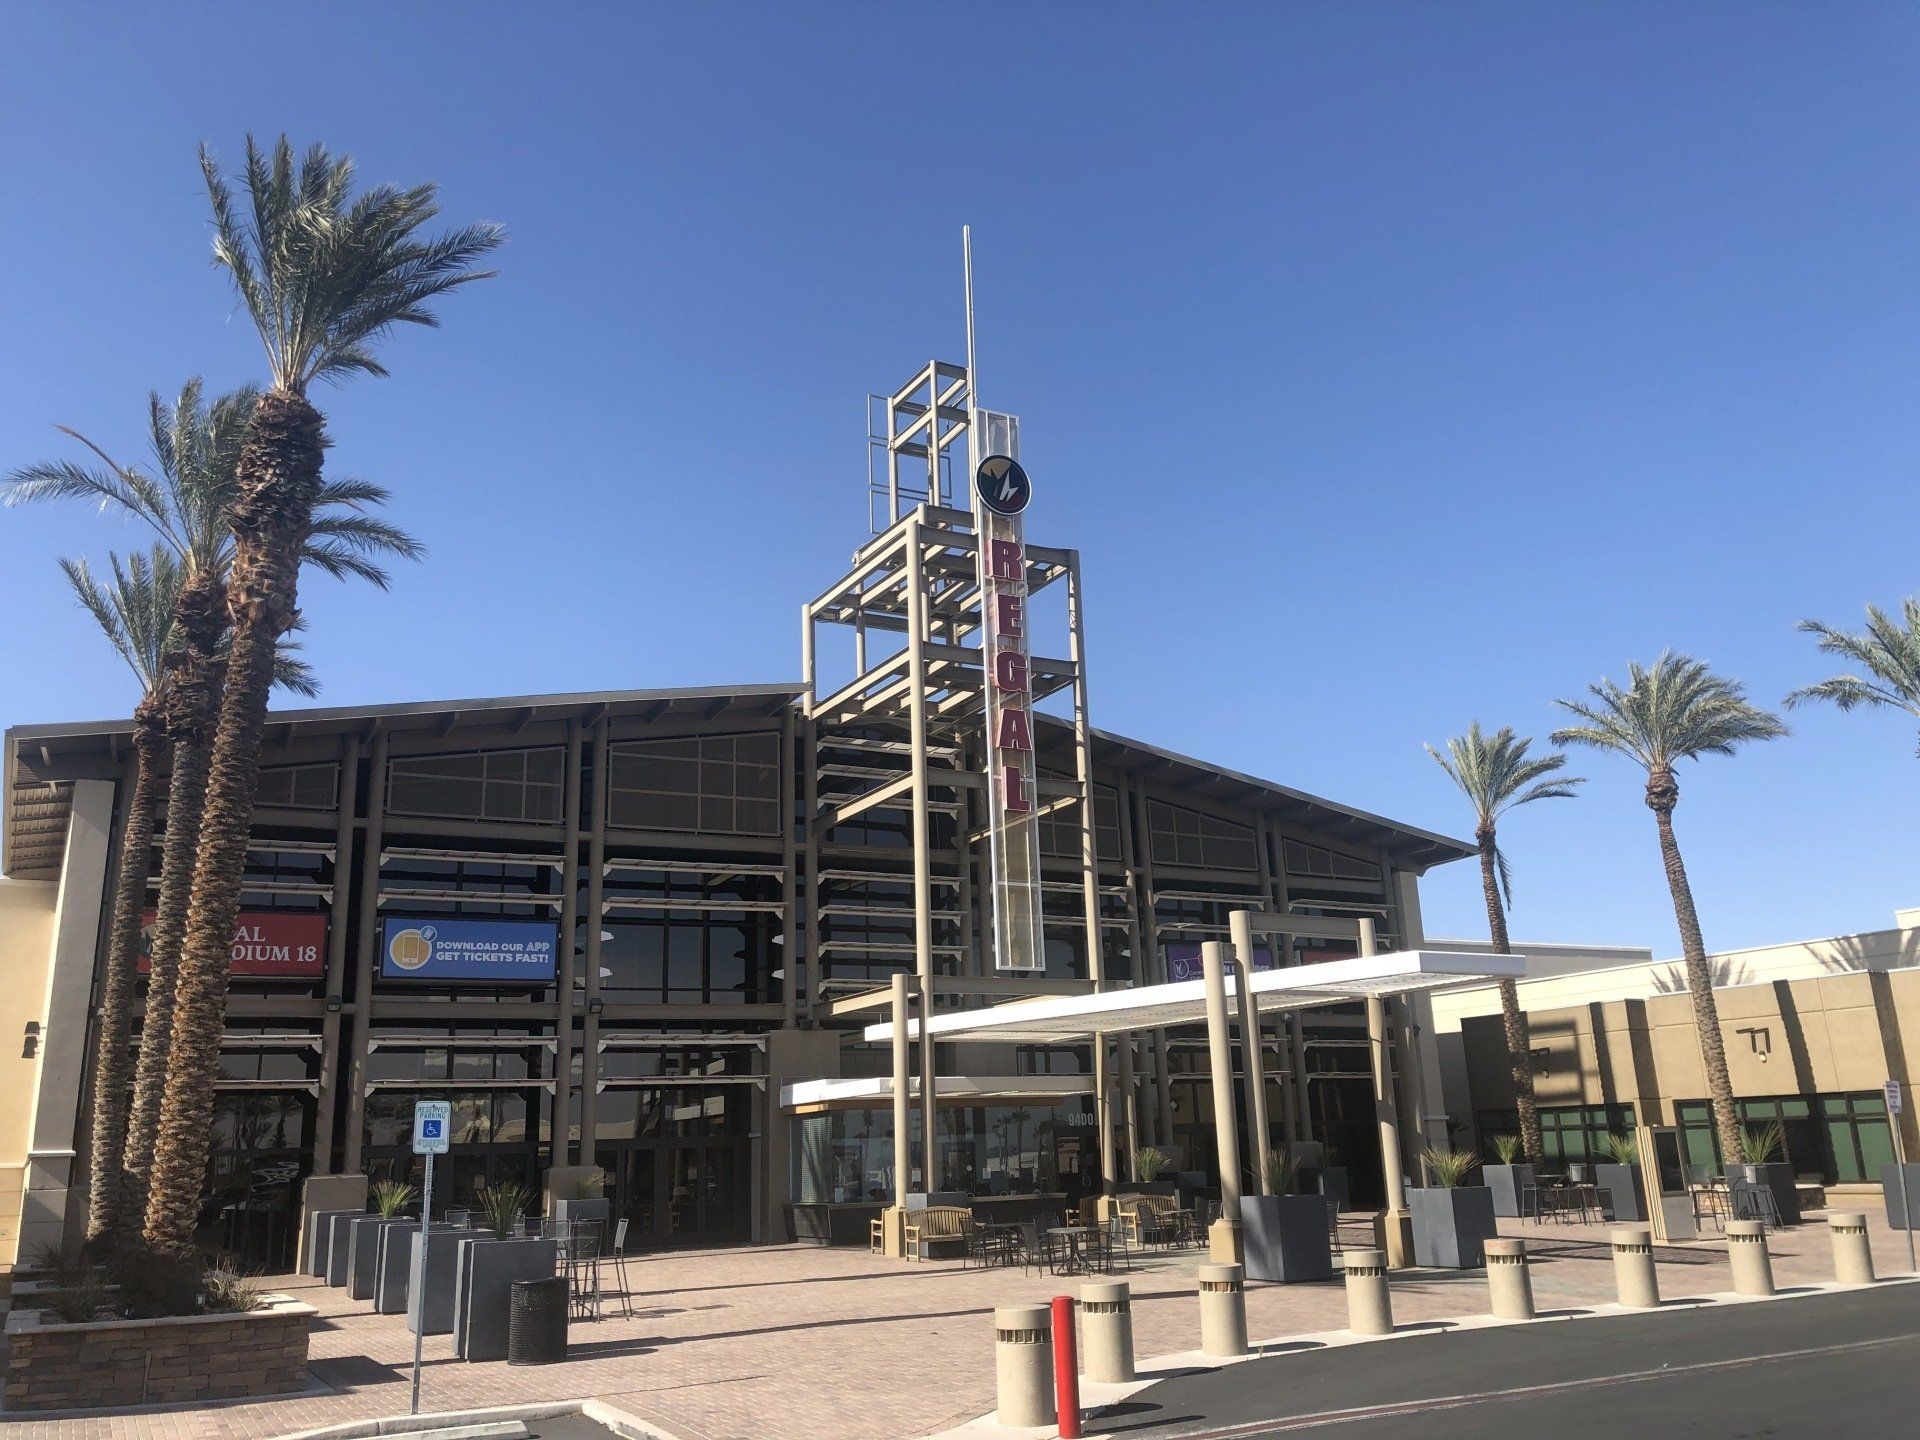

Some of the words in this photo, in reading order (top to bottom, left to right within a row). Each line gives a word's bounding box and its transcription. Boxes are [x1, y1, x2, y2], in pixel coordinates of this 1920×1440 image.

[989, 538, 1032, 812] REGAL
[436, 941, 499, 951] DOWNLOAD
[501, 943, 523, 952] OUR
[526, 941, 550, 952] APP
[296, 945, 317, 962] 18
[436, 951, 461, 961] GET
[463, 952, 513, 962] TICKETS
[515, 953, 549, 963] FAST!
[1068, 1113, 1094, 1126] 9400
